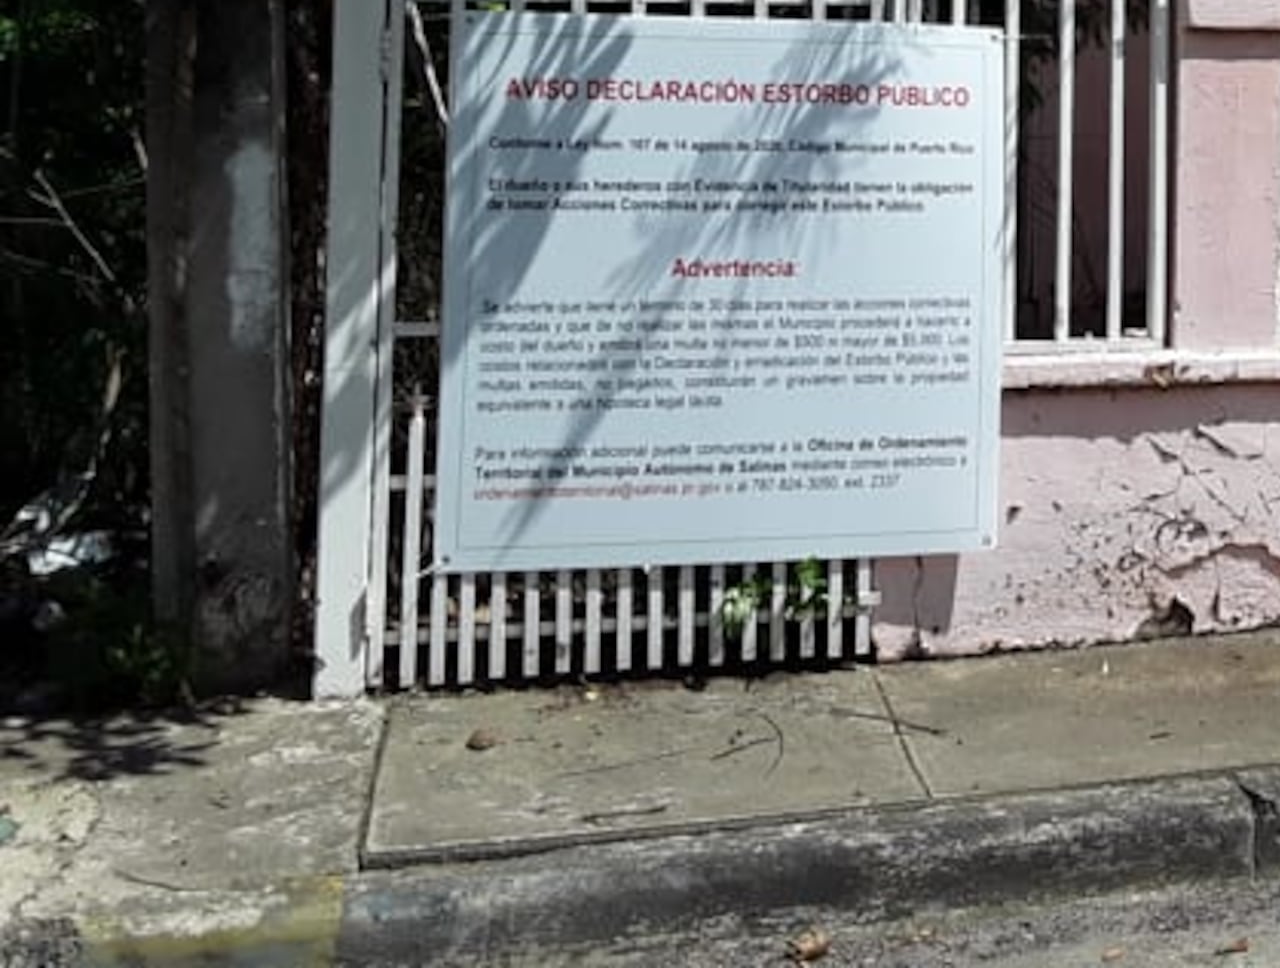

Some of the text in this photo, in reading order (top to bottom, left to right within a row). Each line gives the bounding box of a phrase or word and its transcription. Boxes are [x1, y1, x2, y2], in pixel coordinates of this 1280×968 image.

[507, 79, 579, 101] AVISO
[587, 76, 756, 103] DECLARACIÓN
[763, 83, 870, 105] ESTORBO
[692, 140, 732, 154] agosto
[835, 140, 890, 155] Municipal
[911, 142, 945, 155] Puerto
[951, 142, 974, 155] Rico
[594, 180, 661, 193] herederos
[551, 198, 615, 211] Acciones
[808, 438, 854, 452] Oficina
[572, 463, 639, 479] Municipio
[740, 459, 787, 474] Salinas
